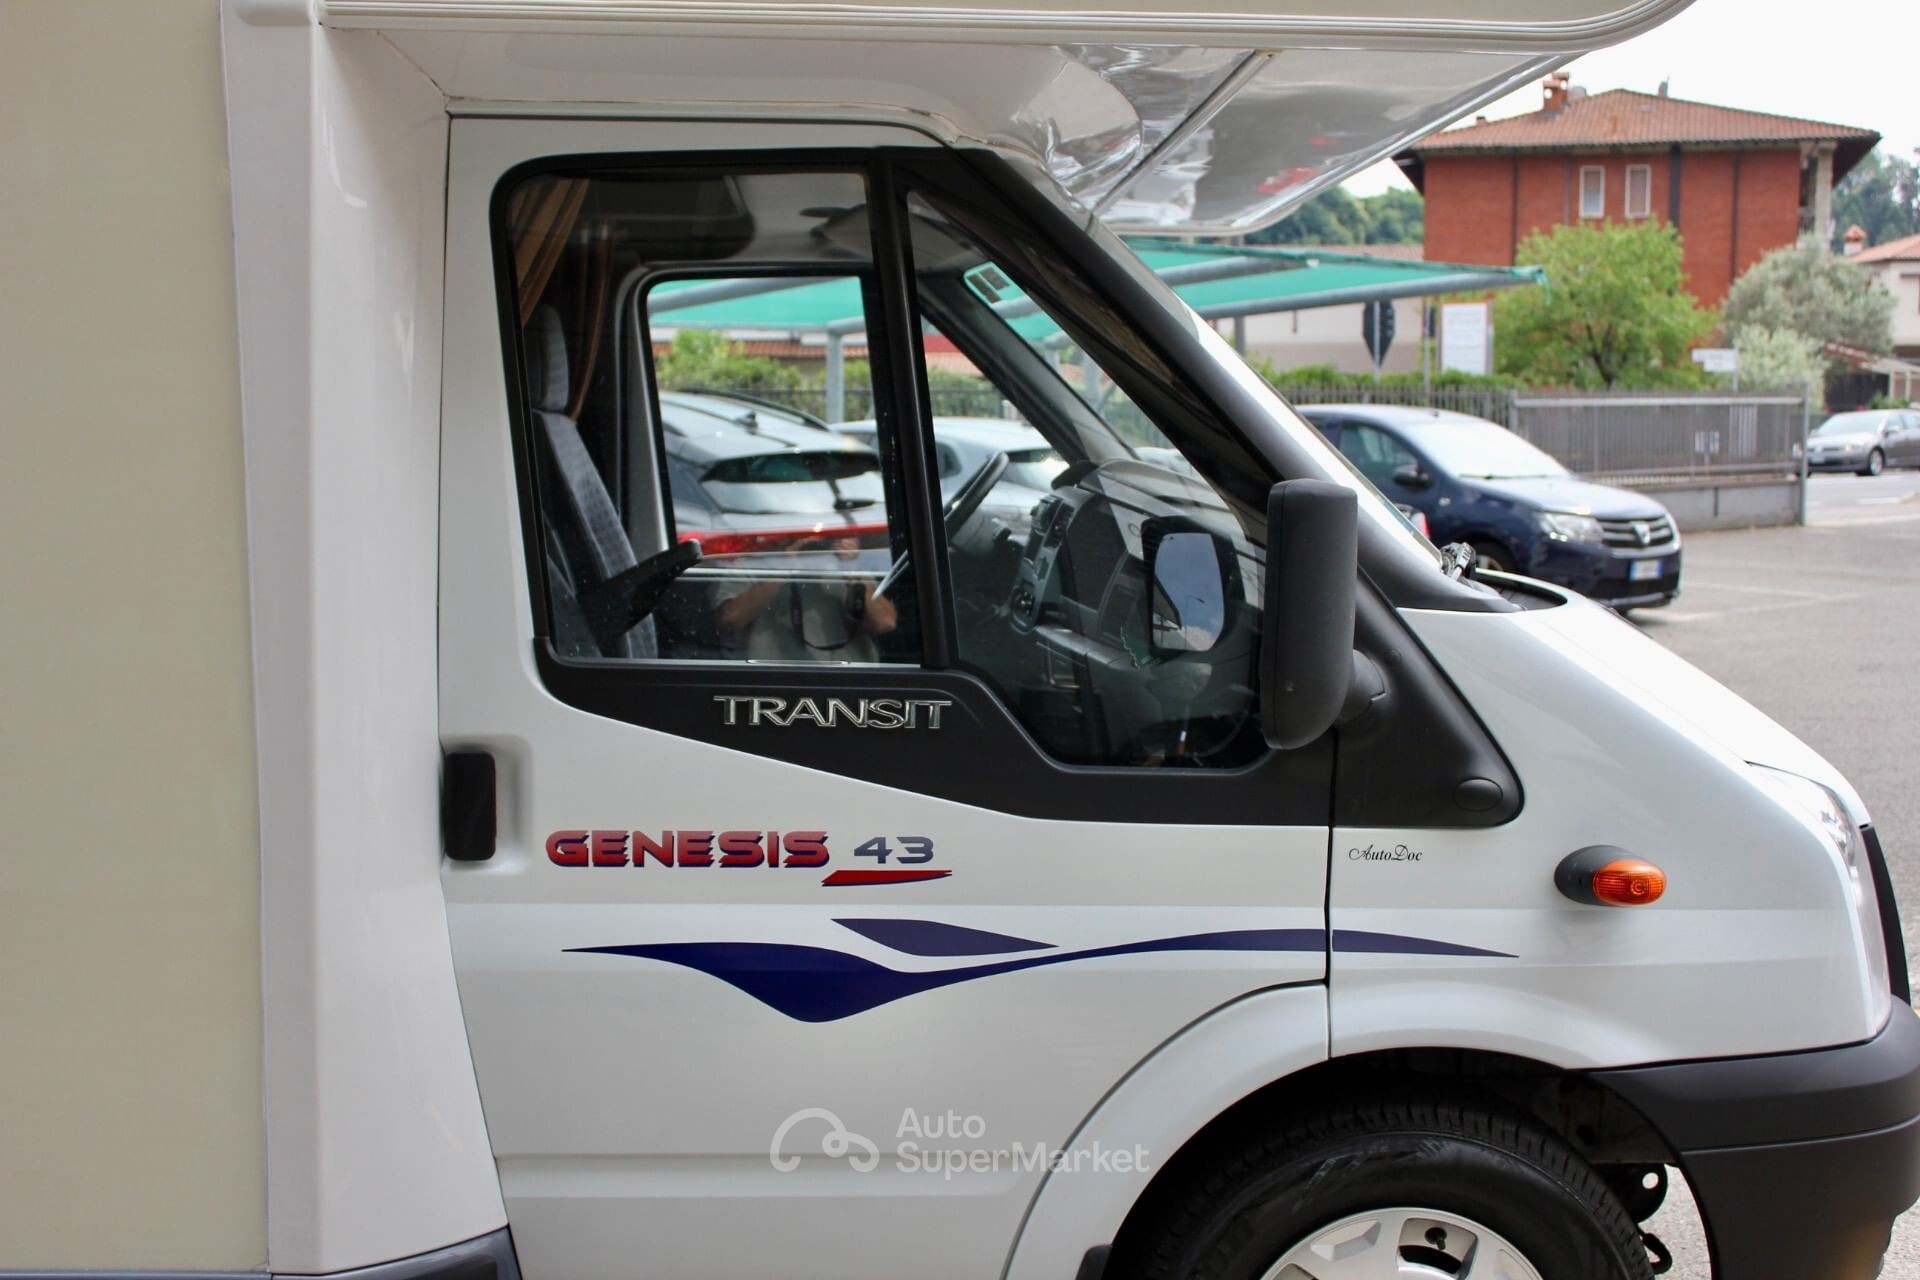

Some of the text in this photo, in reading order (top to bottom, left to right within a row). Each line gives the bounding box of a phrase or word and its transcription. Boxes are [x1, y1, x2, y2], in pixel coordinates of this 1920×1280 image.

[713, 695, 952, 729] TRANSIT
[545, 830, 934, 868] GENESIS 43
